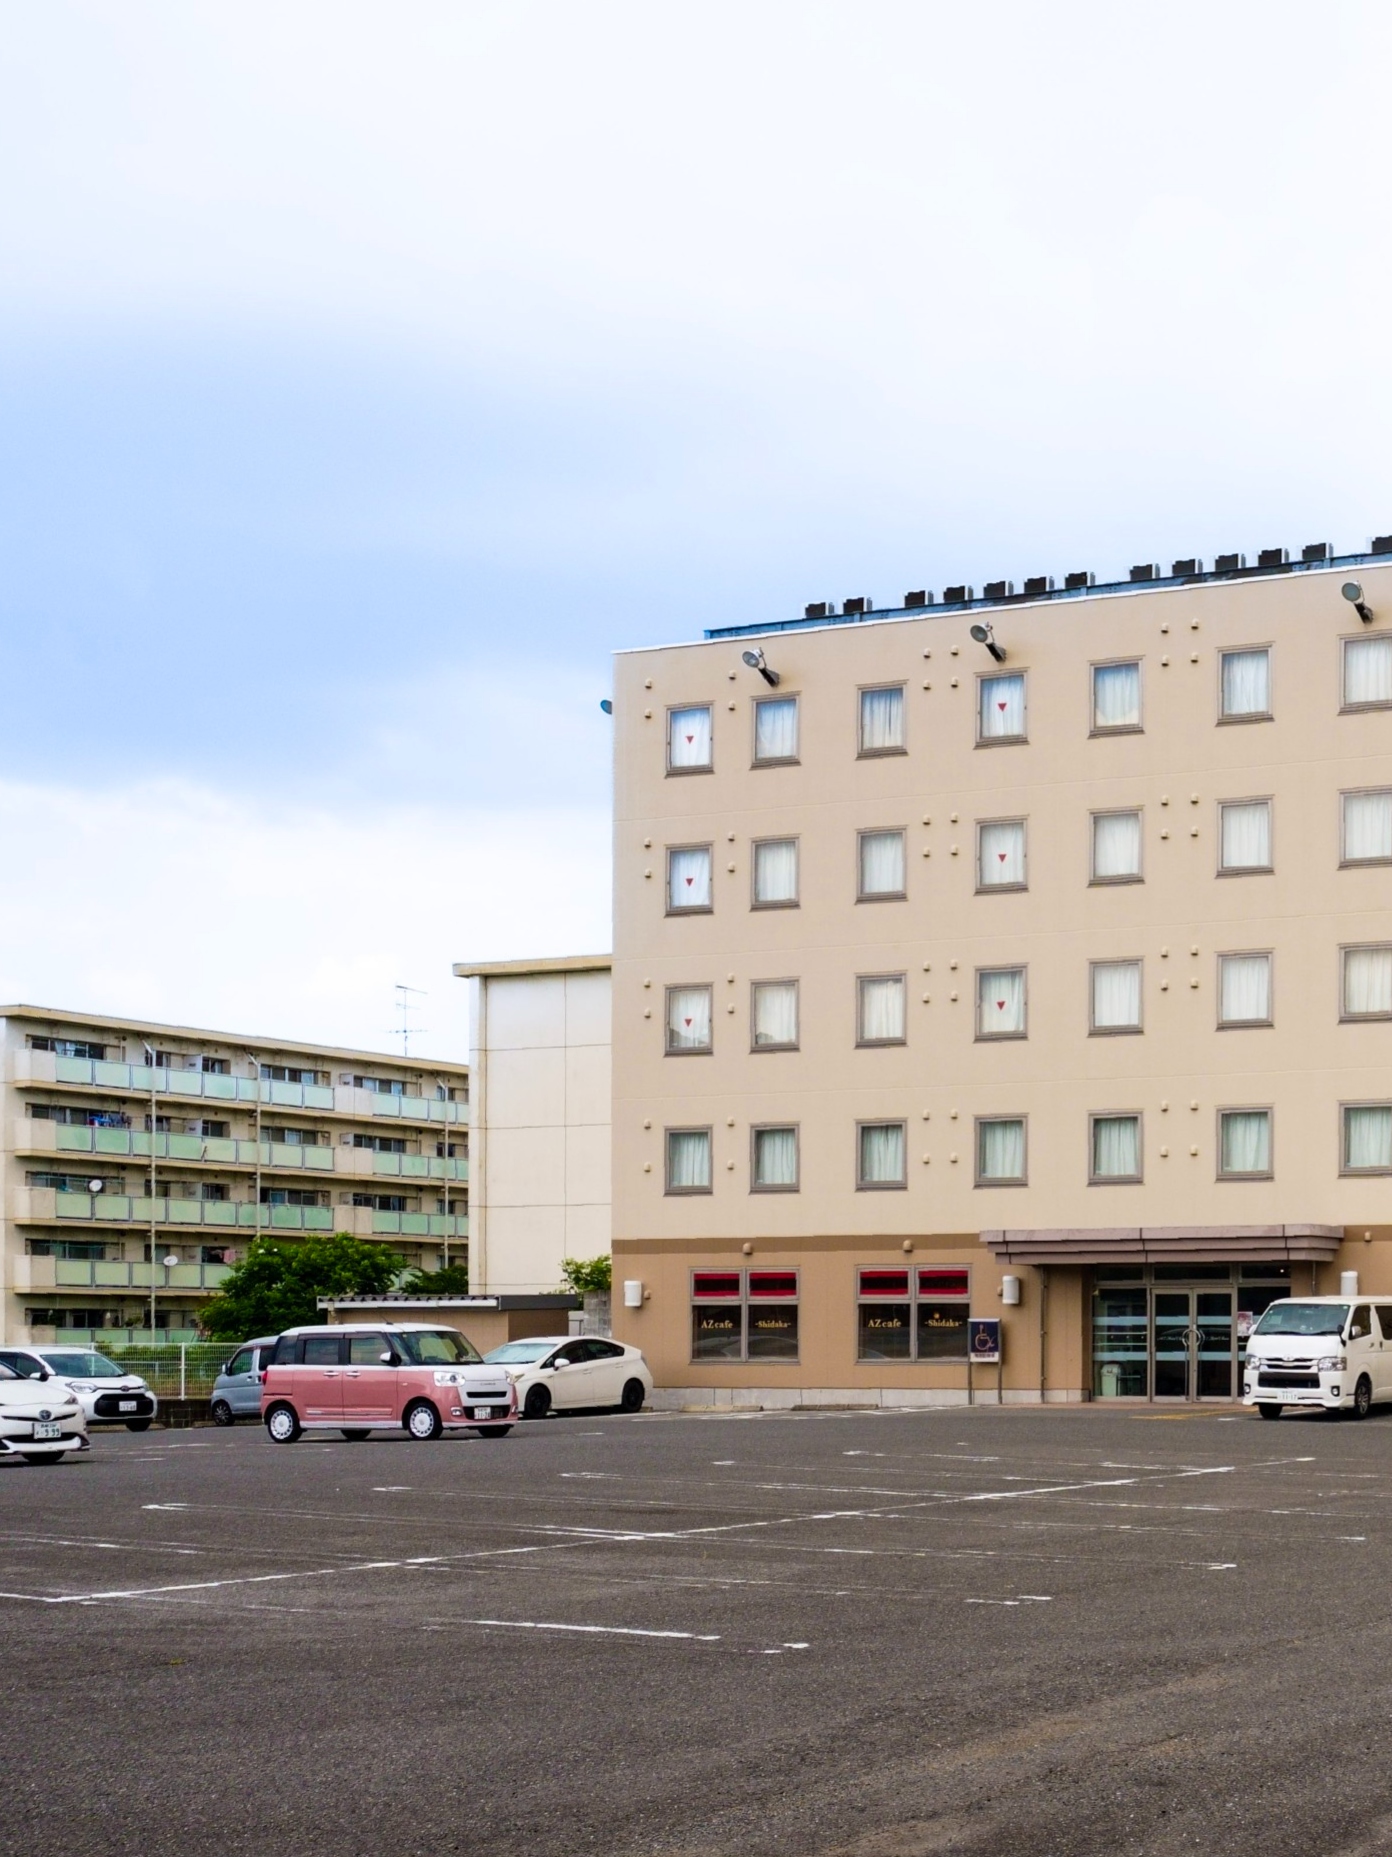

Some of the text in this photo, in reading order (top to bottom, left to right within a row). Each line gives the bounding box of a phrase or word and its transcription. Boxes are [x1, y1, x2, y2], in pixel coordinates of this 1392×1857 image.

[701, 1320, 714, 1329] AZ
[714, 1319, 733, 1329] cafe
[868, 1319, 882, 1328] AZ
[882, 1318, 902, 1328] cafe
